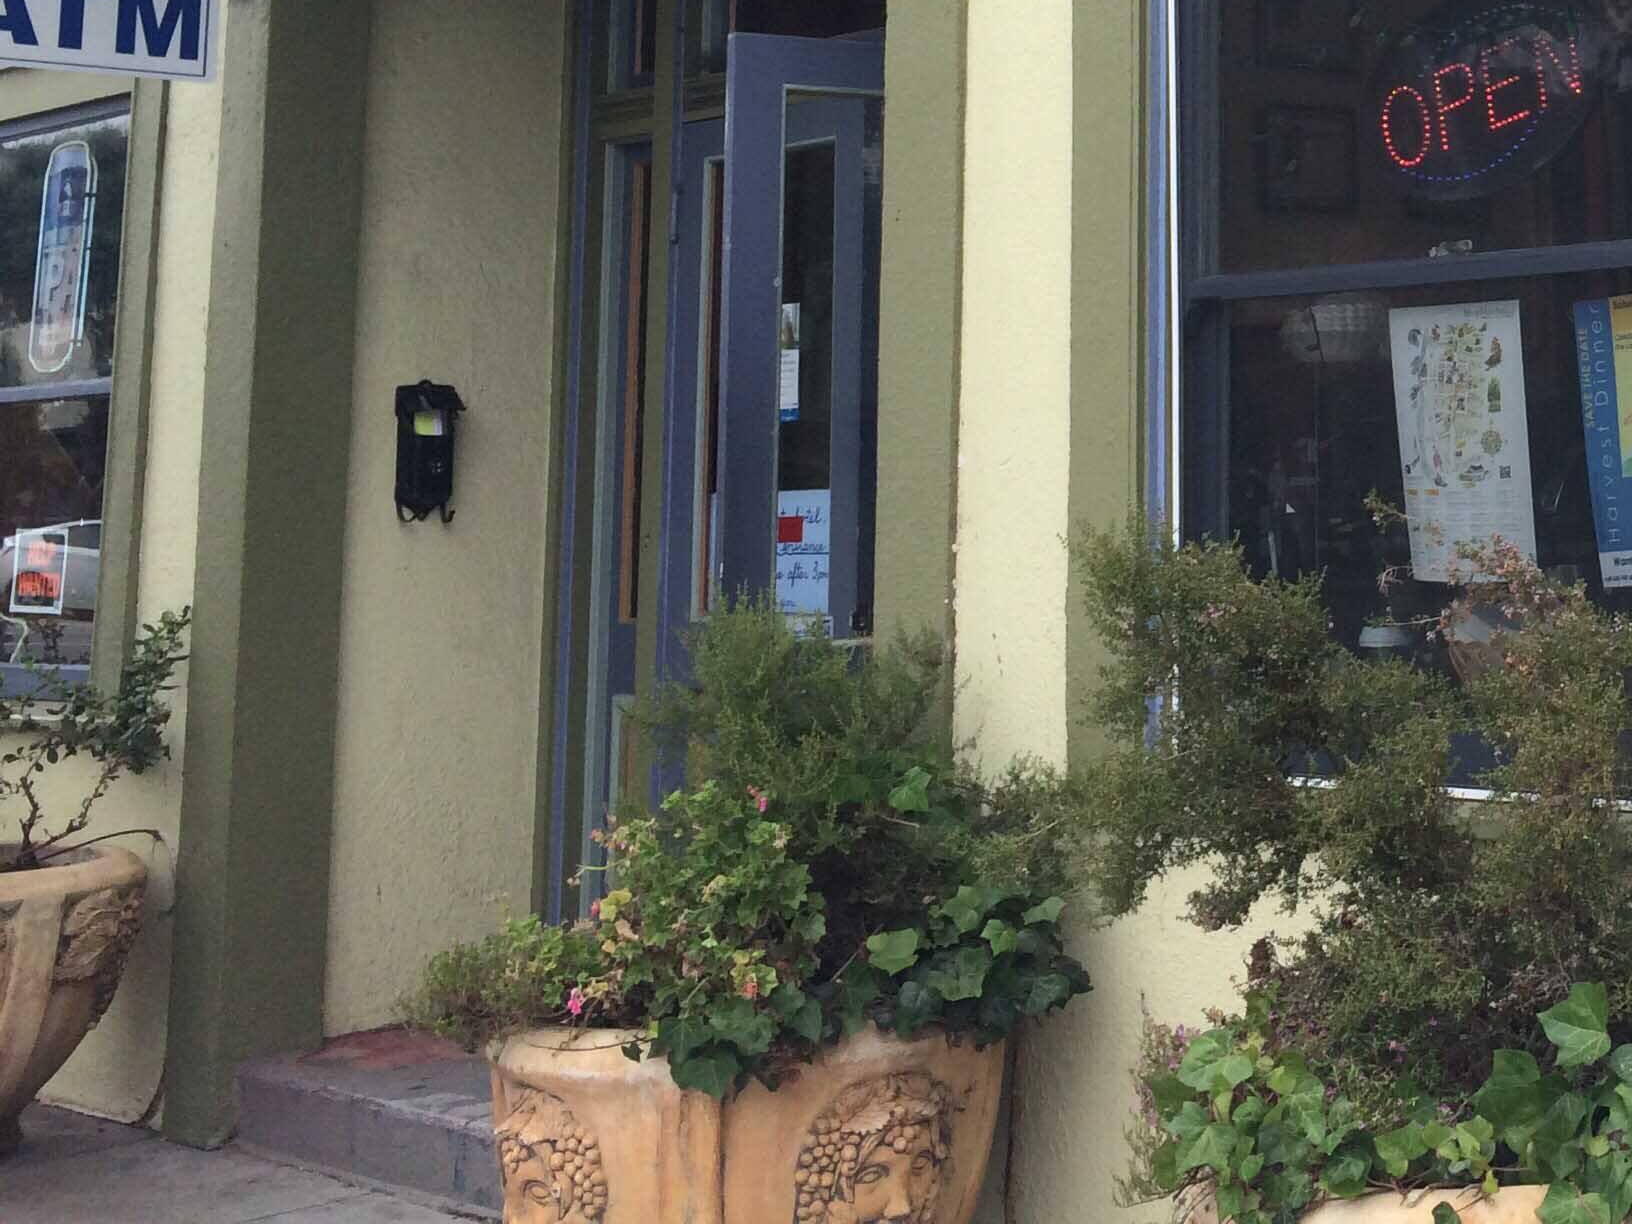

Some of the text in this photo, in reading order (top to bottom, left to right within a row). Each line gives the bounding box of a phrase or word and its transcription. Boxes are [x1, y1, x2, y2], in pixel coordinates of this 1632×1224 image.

[1381, 35, 1581, 167] OPEN
[1589, 303, 1621, 544] Harvest Dinner
